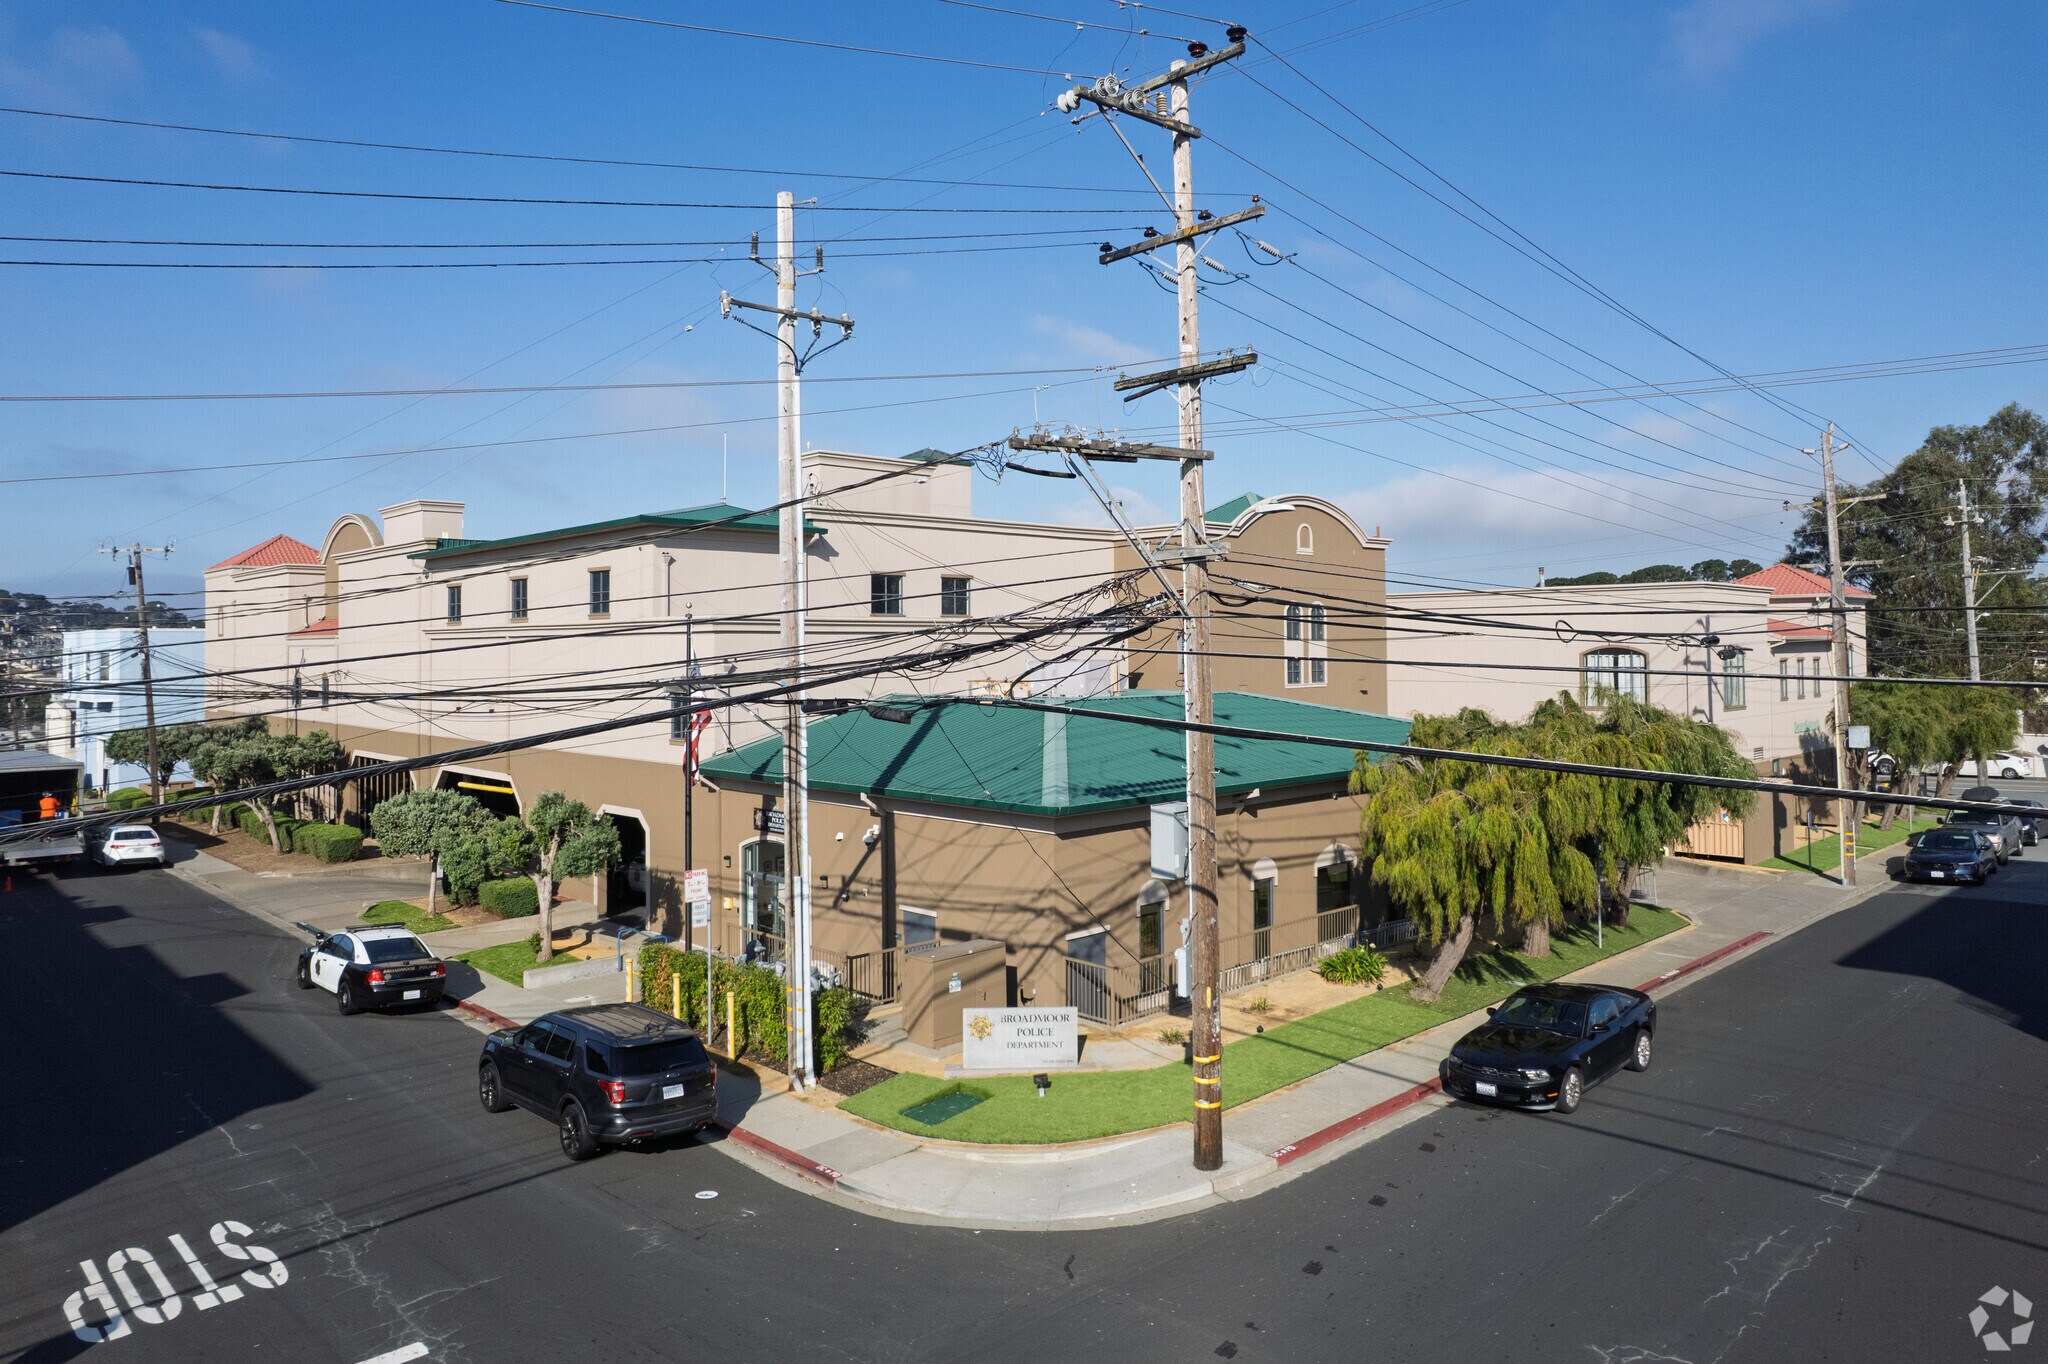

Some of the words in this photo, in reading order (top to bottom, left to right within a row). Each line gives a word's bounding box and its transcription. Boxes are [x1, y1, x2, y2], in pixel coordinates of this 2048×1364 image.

[1001, 1014, 1070, 1023] BROADMOOR
[1017, 1028, 1054, 1037] POLICE
[1007, 1041, 1064, 1049] DEPARTMENT
[63, 1220, 289, 1343] STOP
